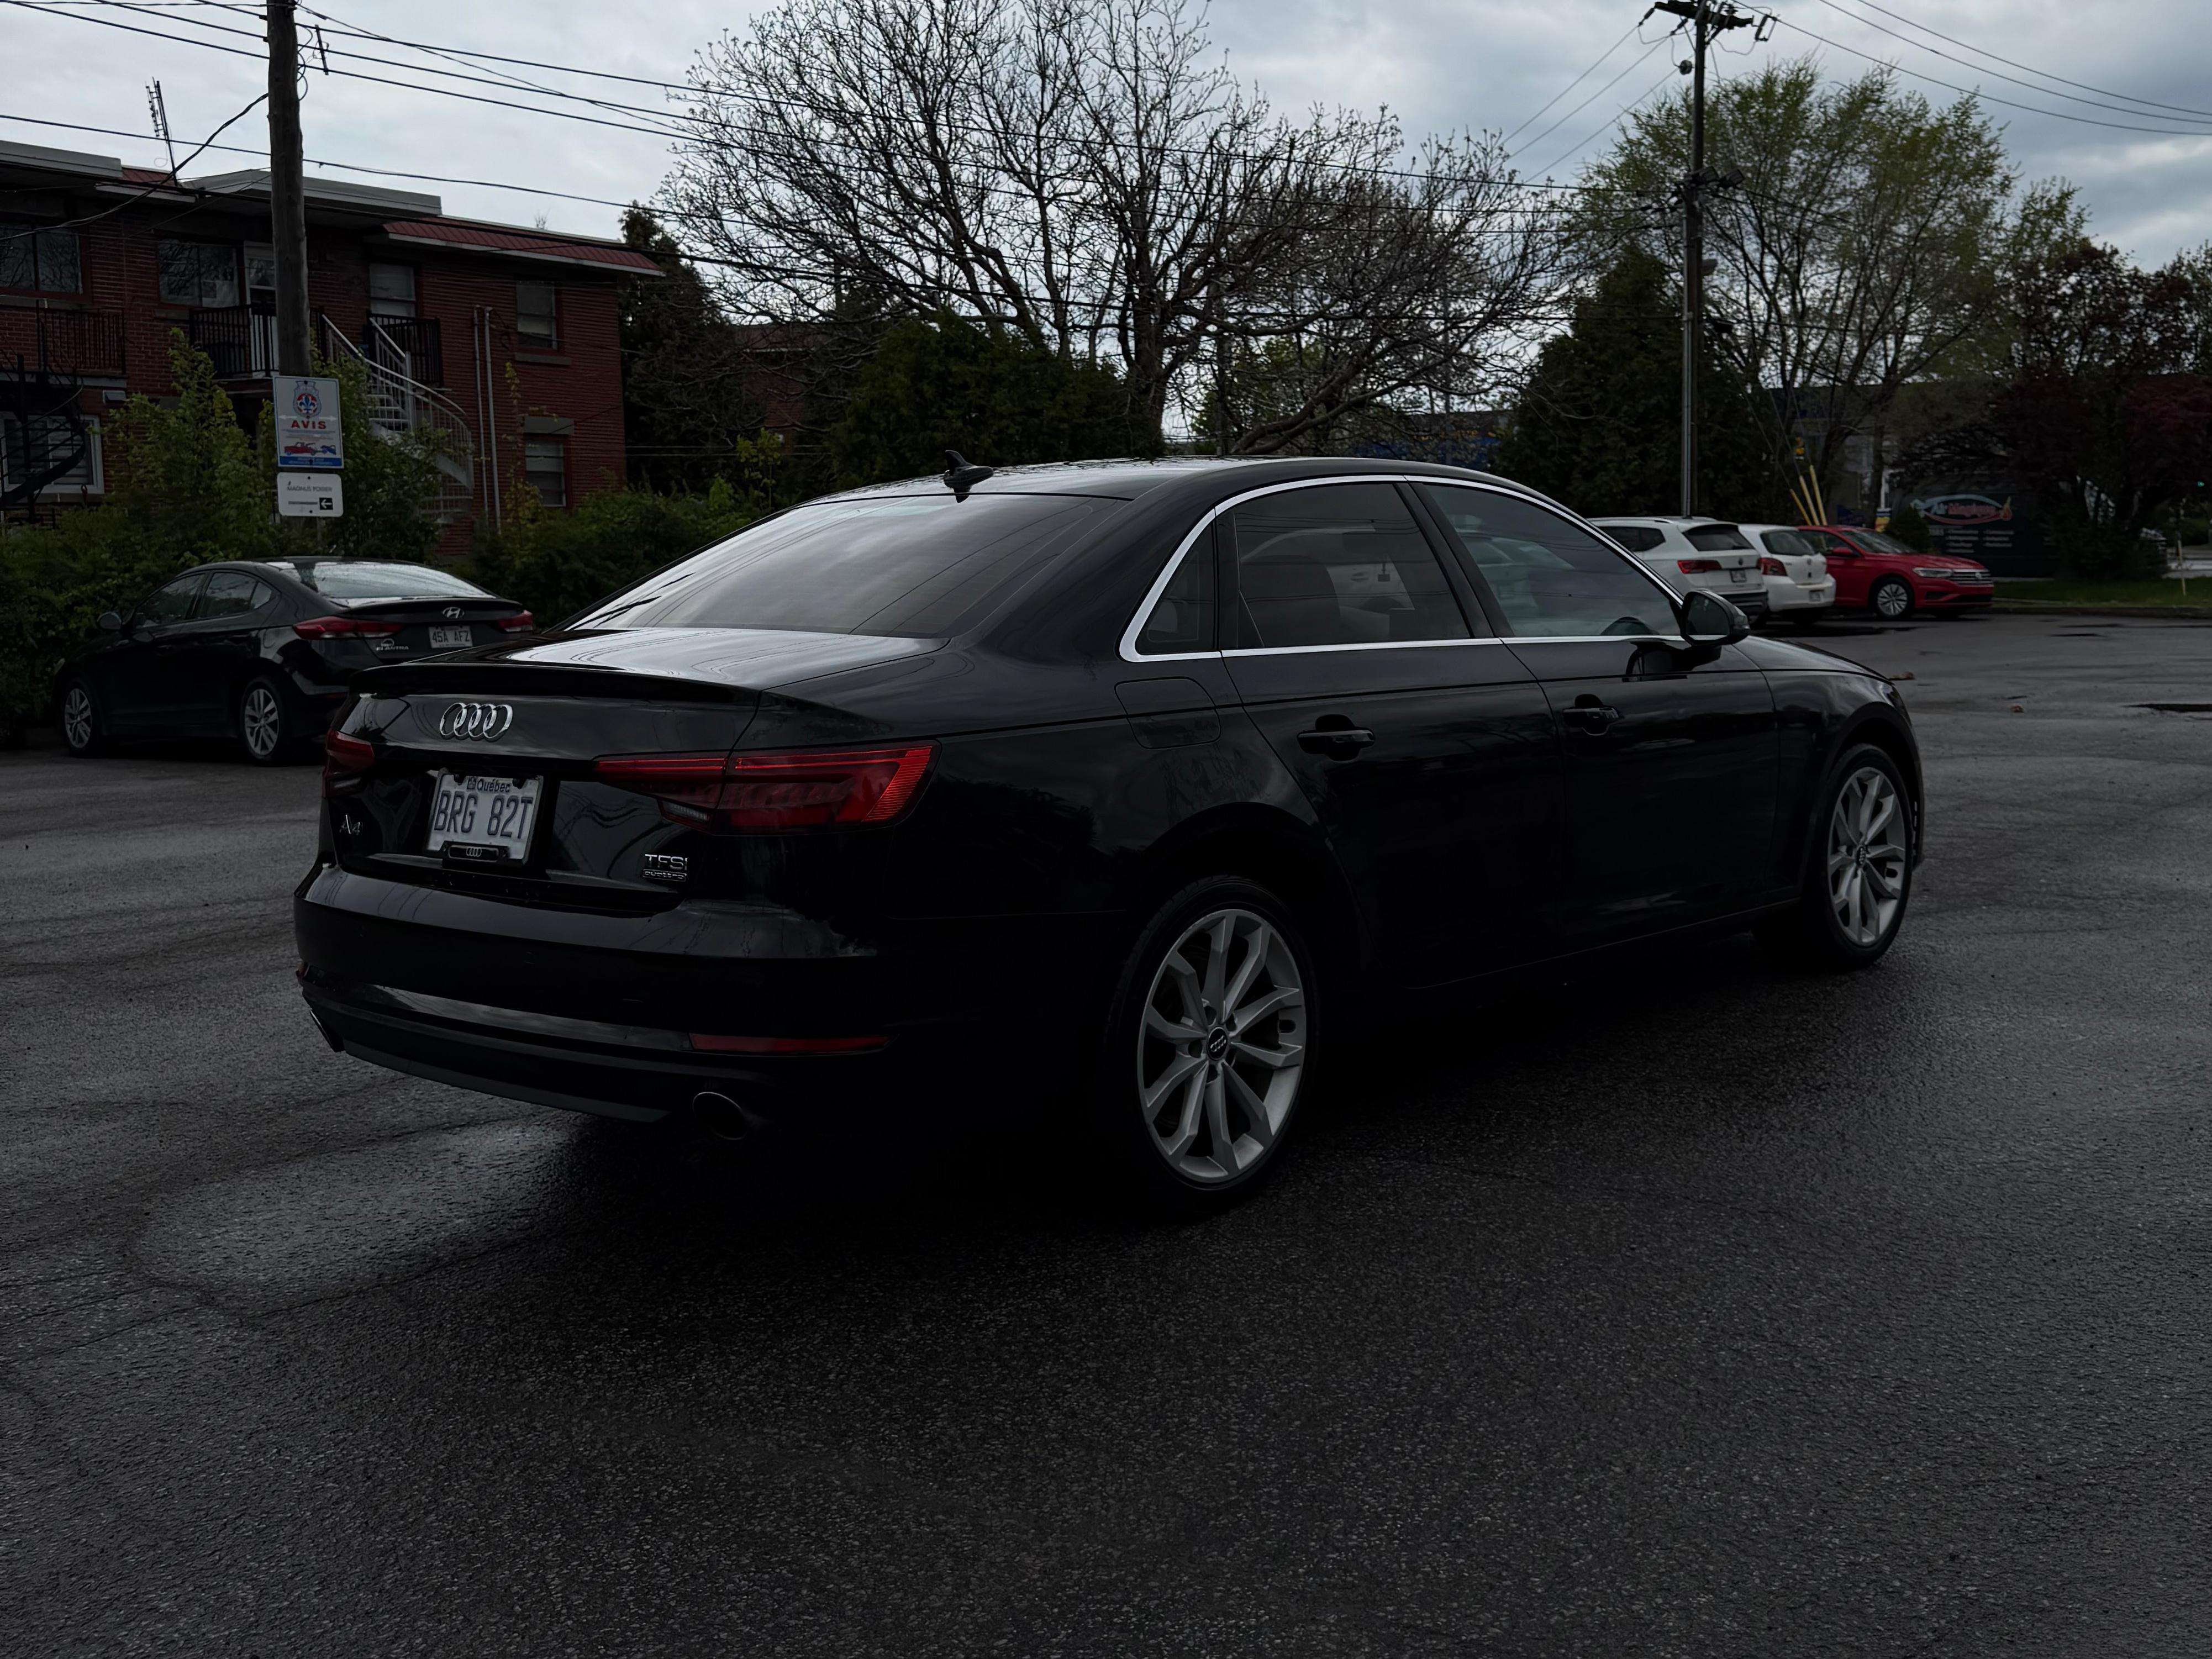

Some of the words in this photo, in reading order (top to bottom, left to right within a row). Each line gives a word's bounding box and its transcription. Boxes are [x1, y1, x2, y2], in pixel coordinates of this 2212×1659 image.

[291, 420, 326, 429] AVIS
[433, 631, 449, 642] 45A
[455, 630, 470, 642] AFZ
[476, 779, 511, 793] Québec
[434, 791, 478, 833] BRG
[487, 796, 534, 839] 82T
[644, 854, 688, 871] TFSI
